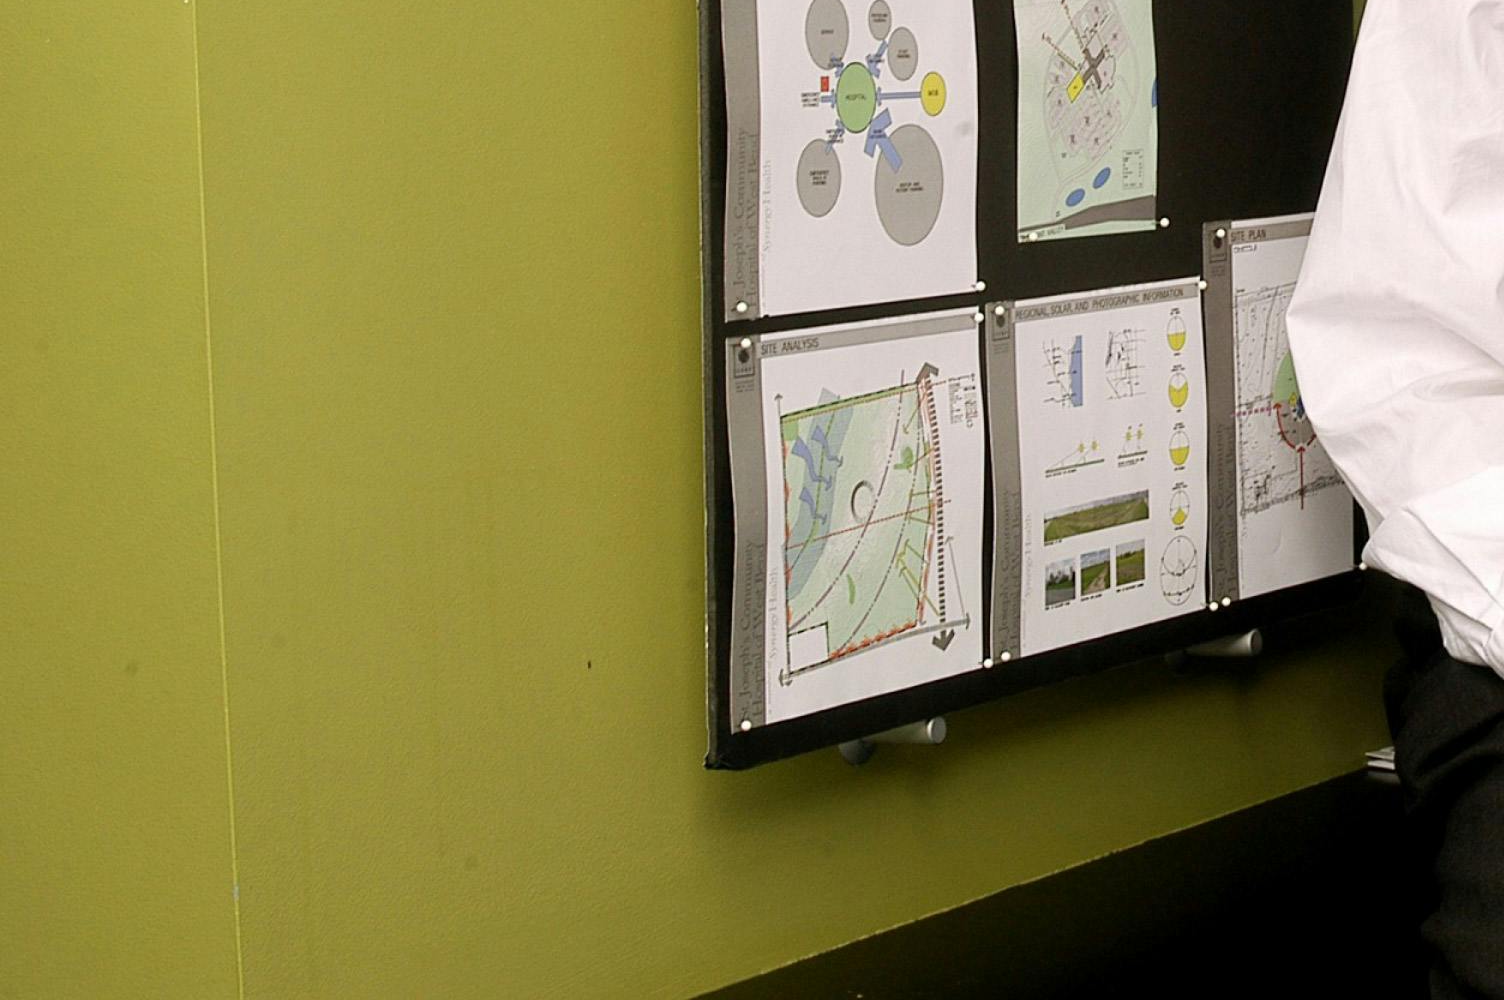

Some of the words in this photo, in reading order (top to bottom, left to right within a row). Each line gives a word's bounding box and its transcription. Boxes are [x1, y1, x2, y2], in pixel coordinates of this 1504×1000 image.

[734, 127, 747, 219] Community
[747, 183, 757, 221] West
[733, 226, 746, 287] Joseph's
[1230, 230, 1245, 242] SITE
[1248, 228, 1267, 240] PLAN
[1015, 306, 1049, 320] REGIONAL
[1050, 302, 1073, 315] SOLAR
[1074, 300, 1090, 312] AND
[1142, 287, 1184, 303] INFORMATION
[761, 343, 778, 355] SITE
[781, 337, 820, 352] ANALYSIS
[740, 541, 754, 631] Community
[752, 593, 763, 630] West
[739, 634, 752, 697] Joseph's
[751, 654, 765, 716] Hospital
